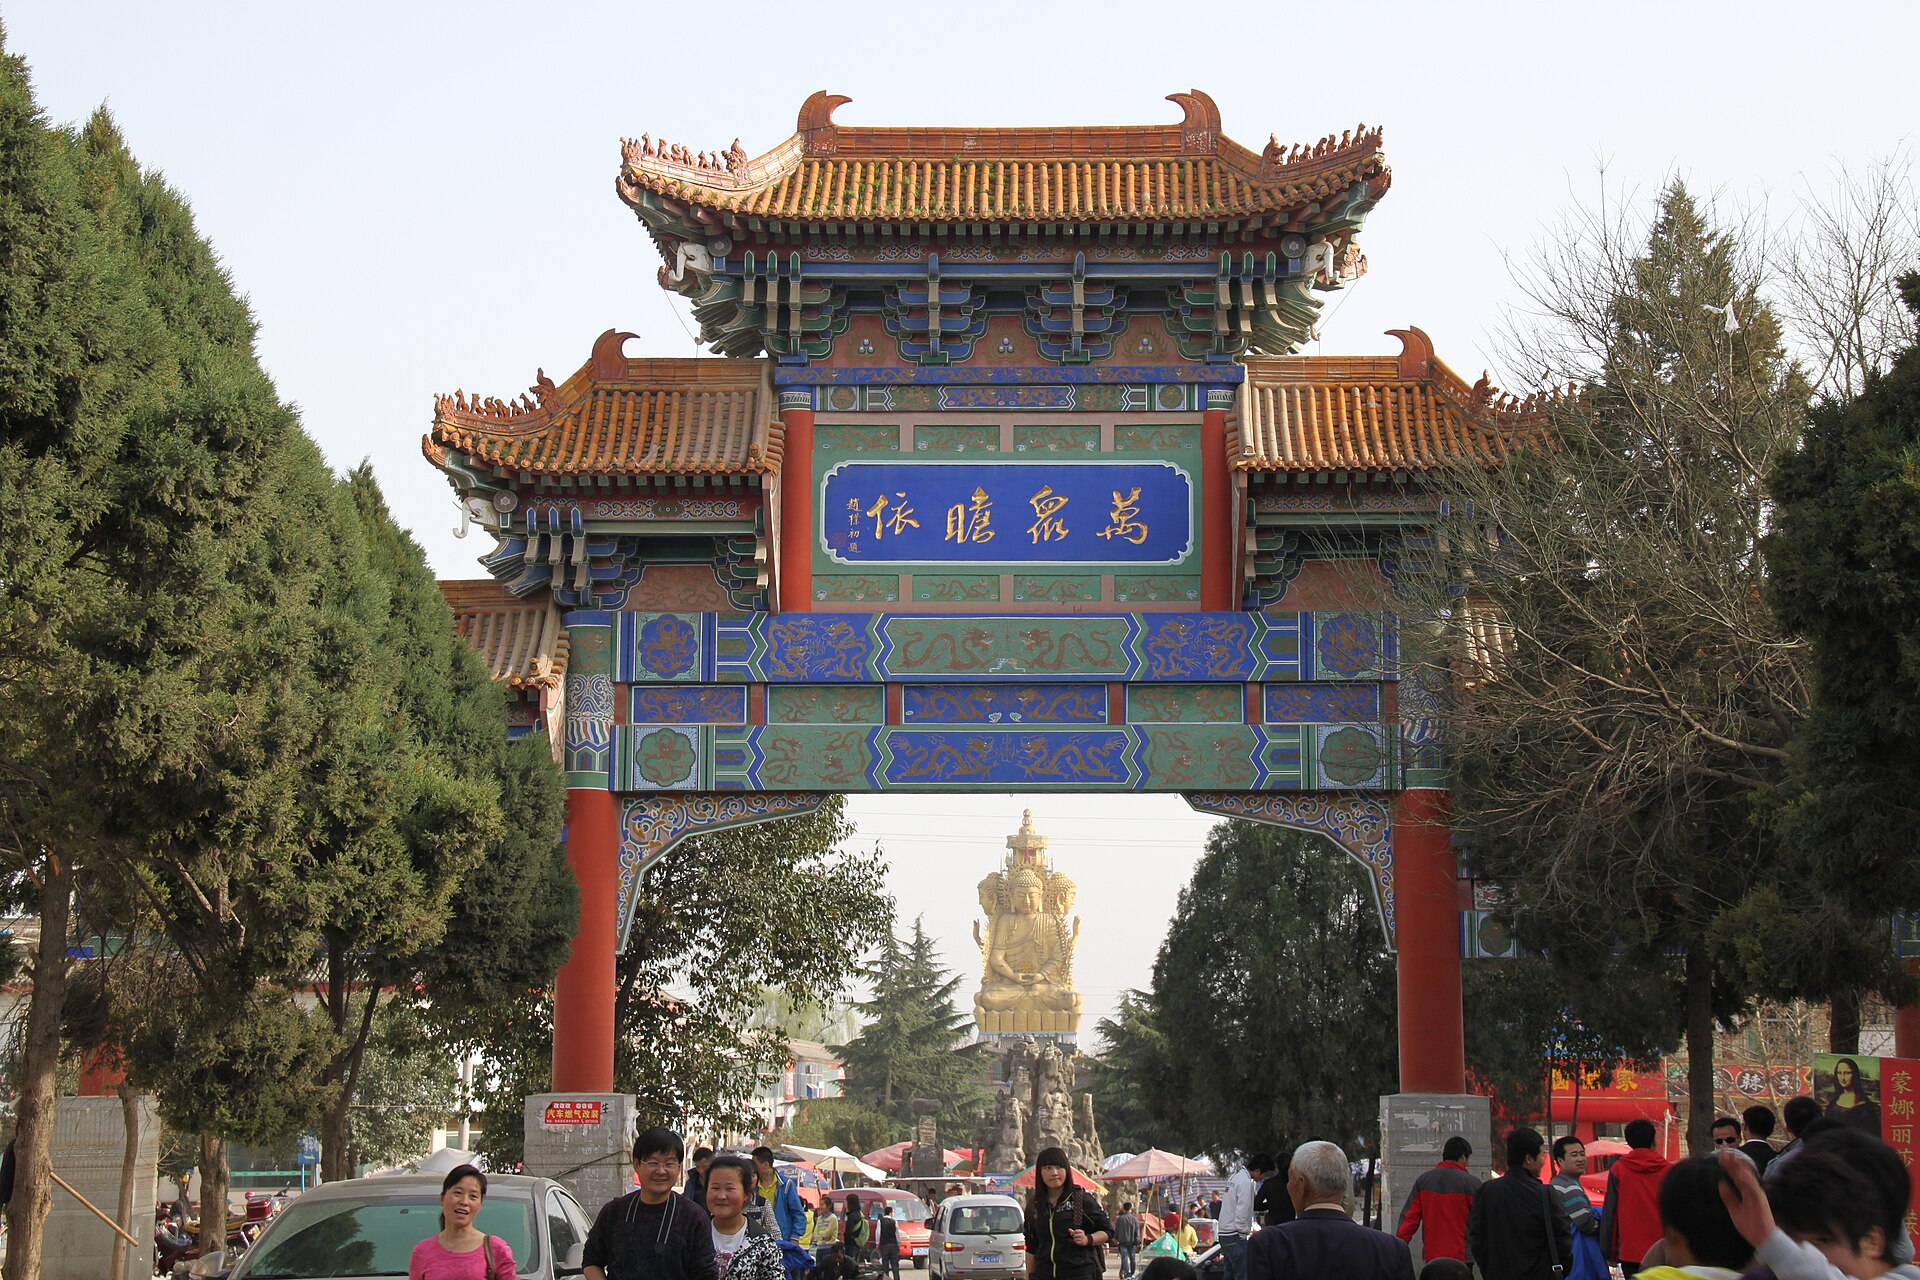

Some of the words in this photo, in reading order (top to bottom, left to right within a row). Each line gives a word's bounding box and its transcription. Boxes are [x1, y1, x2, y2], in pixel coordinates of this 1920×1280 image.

[547, 1109, 599, 1118] 汽车燃气改装
